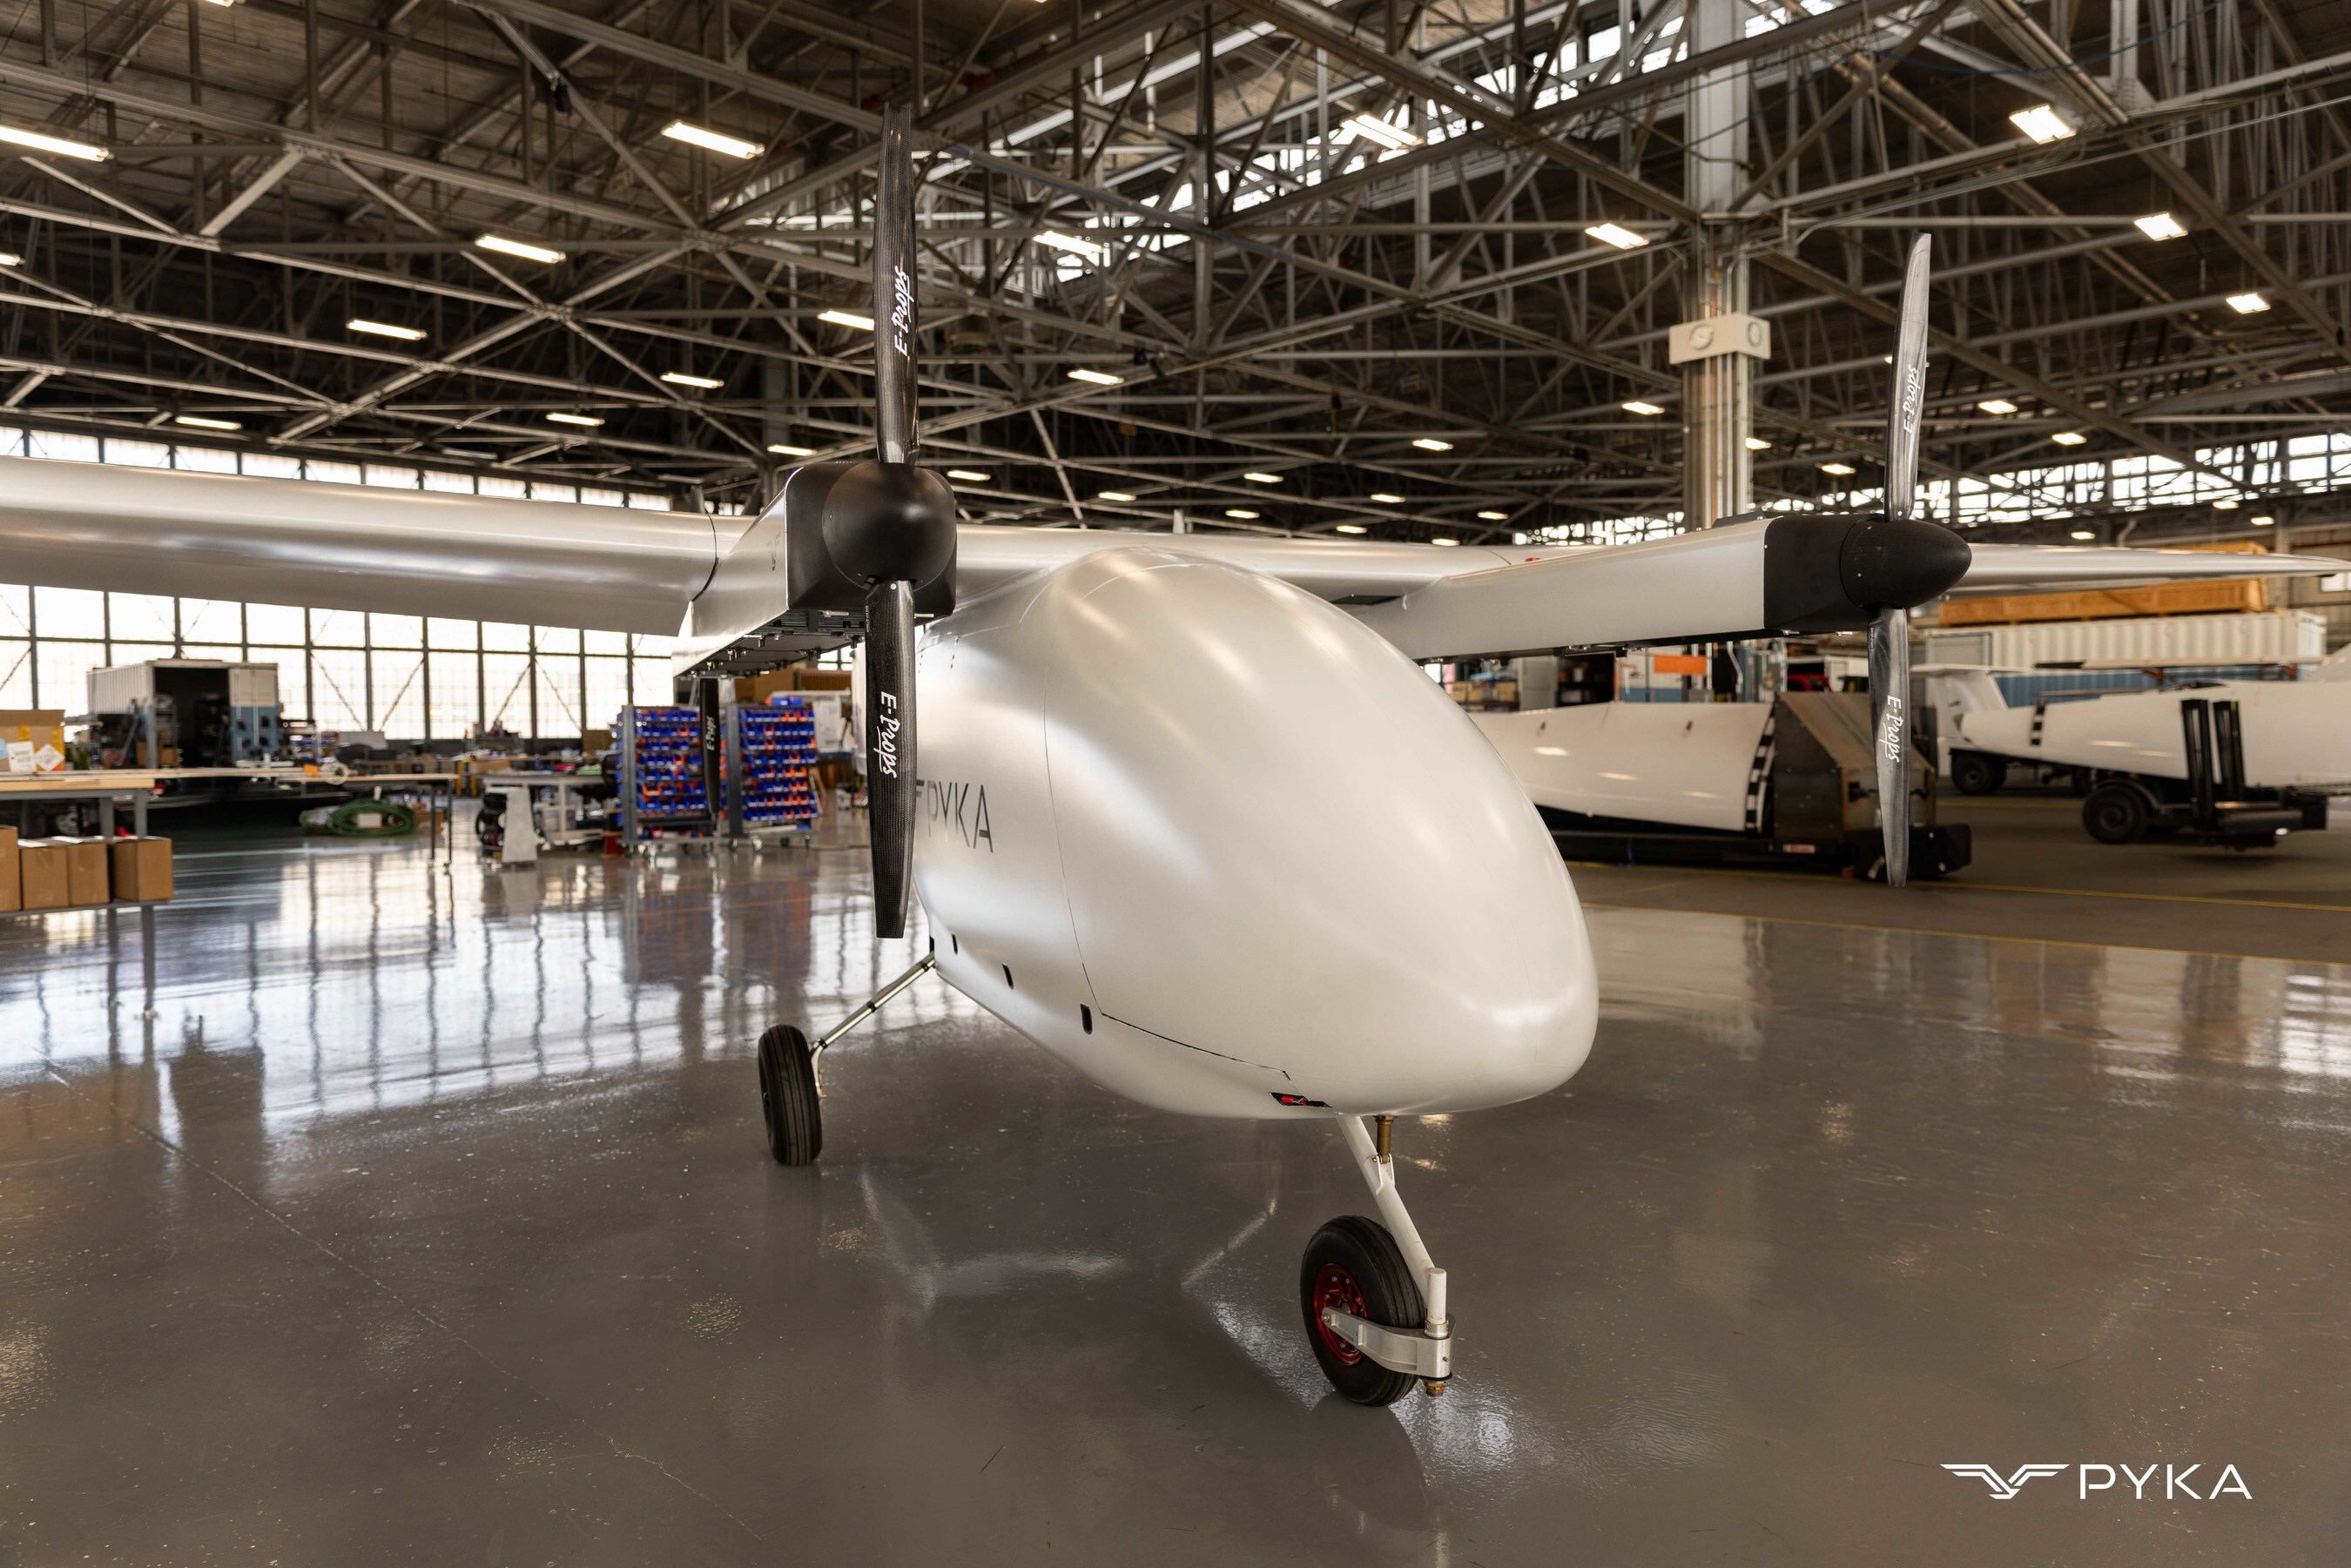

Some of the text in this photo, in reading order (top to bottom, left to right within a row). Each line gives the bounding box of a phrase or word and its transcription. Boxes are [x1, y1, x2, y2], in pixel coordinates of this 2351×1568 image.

[891, 266, 914, 356] E-Props
[1903, 364, 1921, 434] E-Props
[873, 691, 901, 778] E-Props
[1879, 695, 1904, 763] E-Props
[927, 779, 994, 853] PYKA
